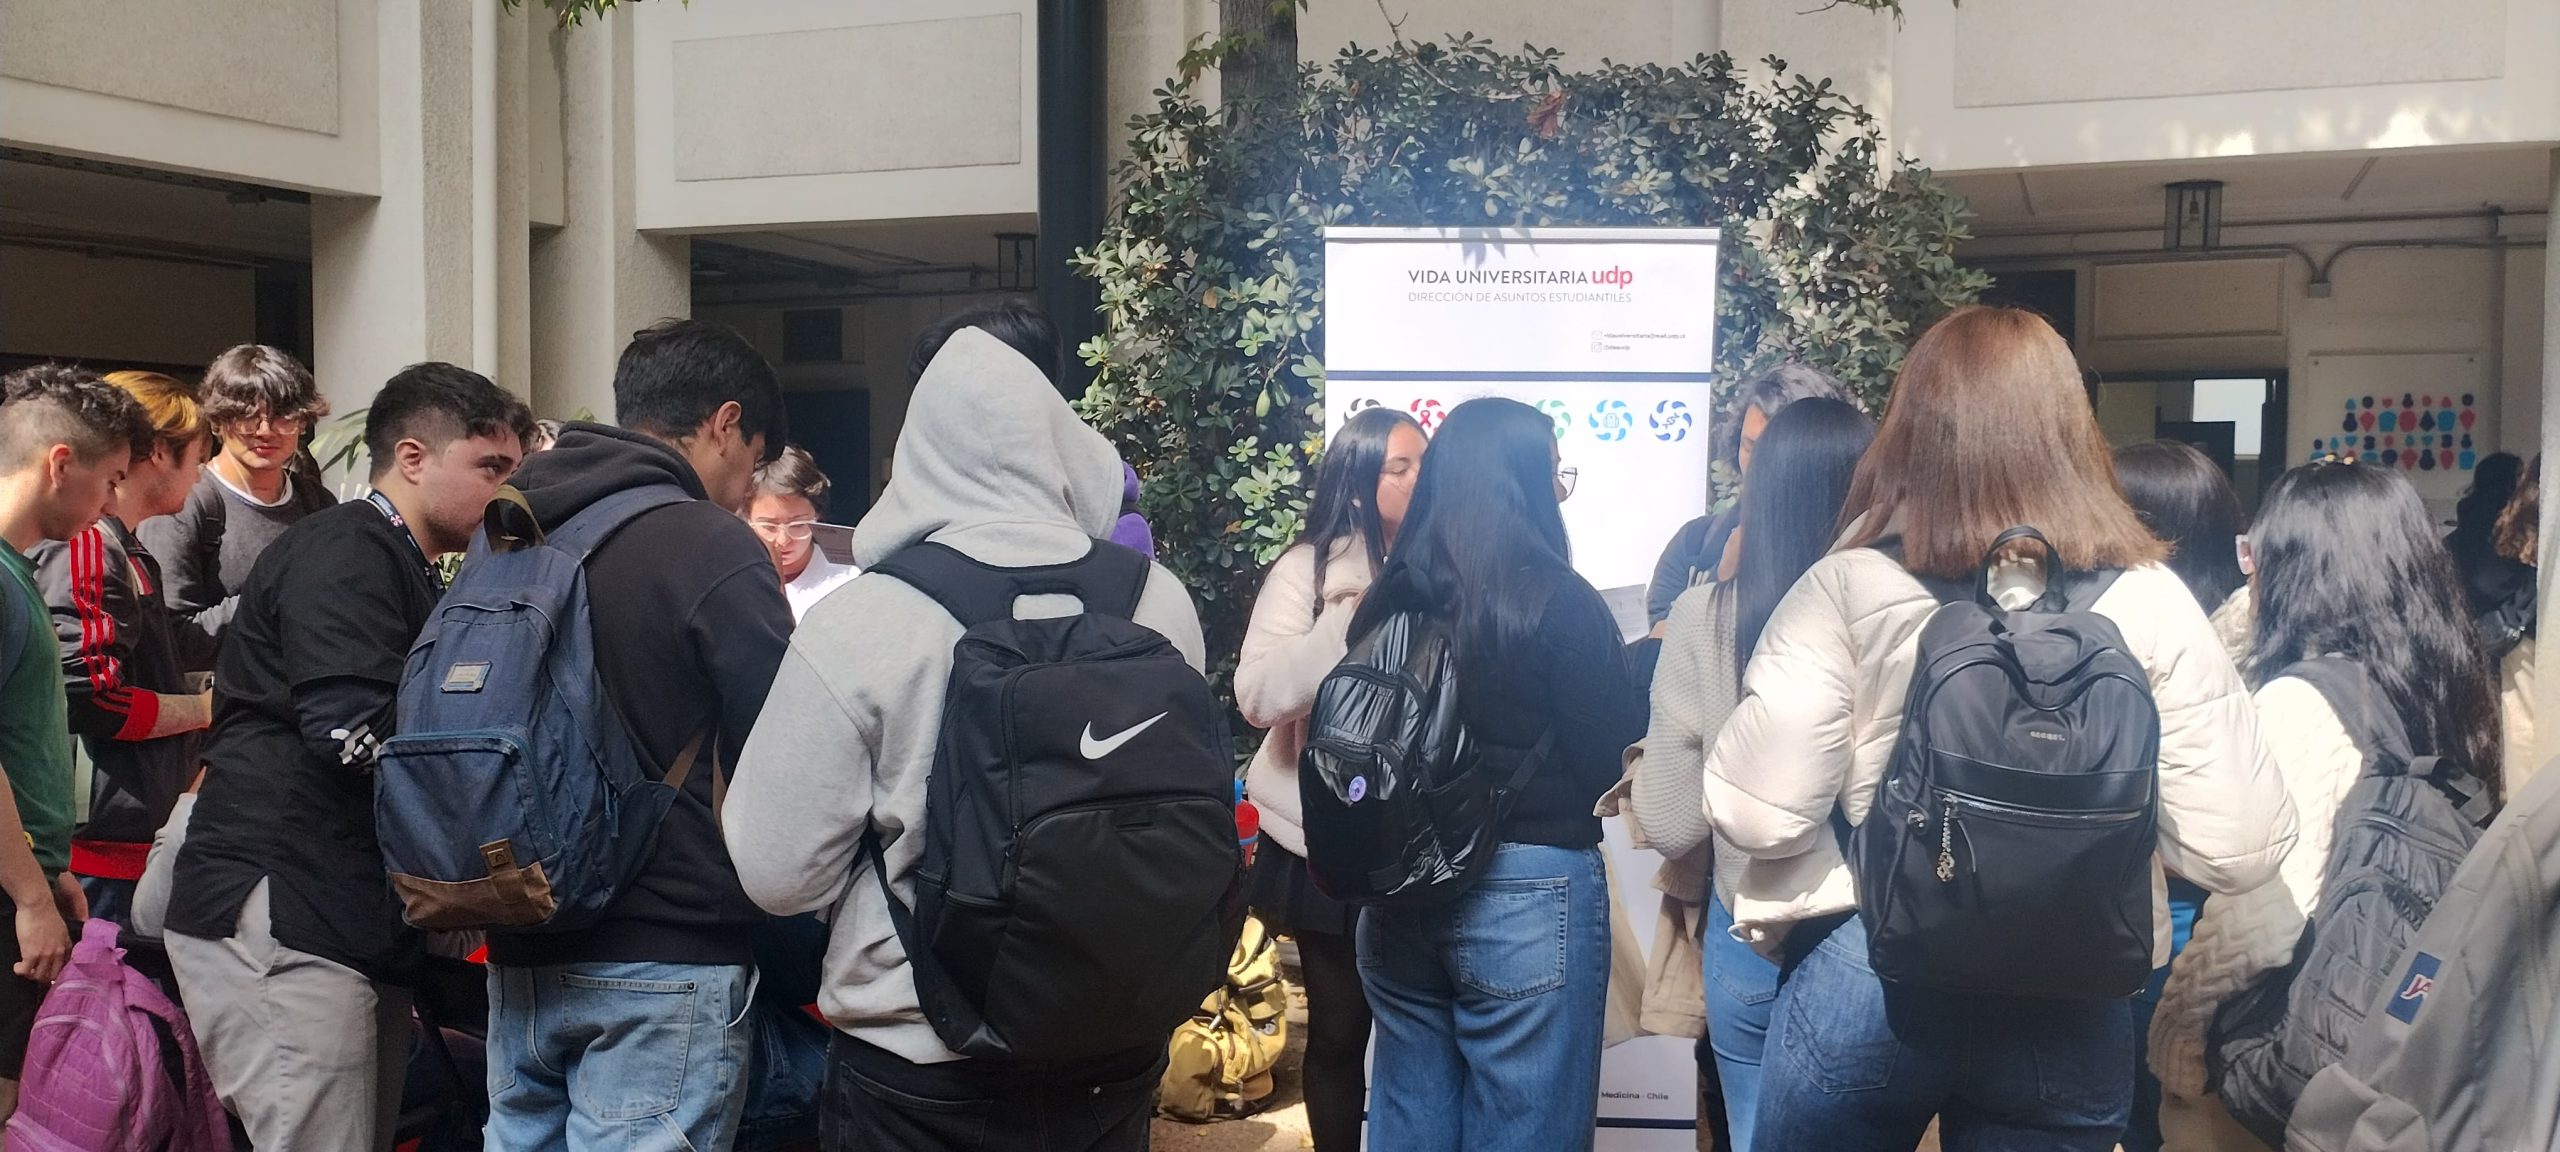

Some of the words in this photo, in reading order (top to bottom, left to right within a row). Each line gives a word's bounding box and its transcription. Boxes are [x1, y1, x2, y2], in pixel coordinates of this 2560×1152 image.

[1407, 270, 1451, 284] VIDA
[1456, 270, 1588, 284] UNIVERSITARIA
[1592, 265, 1633, 290] udp
[1408, 289, 1473, 302] DIRECCIÓN
[1476, 292, 1491, 302] DE
[1493, 292, 1546, 302] ASUNTOS
[1549, 292, 1632, 302] ESTUDIANTILES
[1601, 1091, 1640, 1100] Medicina
[1646, 1092, 1669, 1100] Chile
